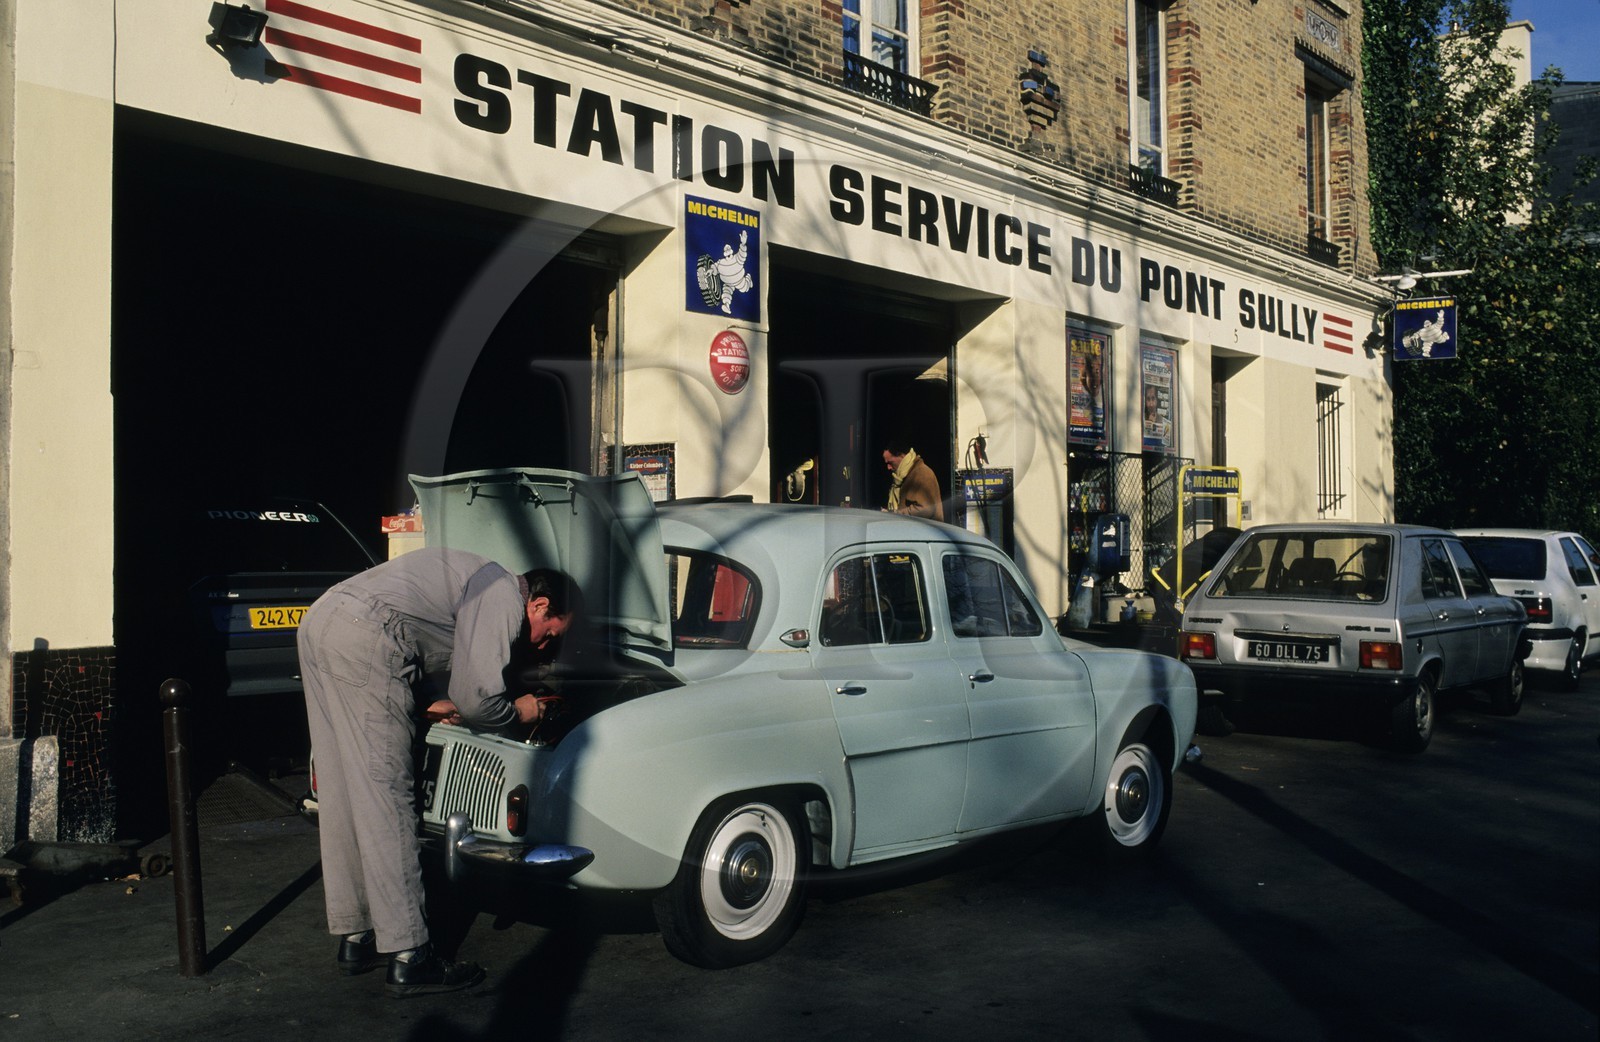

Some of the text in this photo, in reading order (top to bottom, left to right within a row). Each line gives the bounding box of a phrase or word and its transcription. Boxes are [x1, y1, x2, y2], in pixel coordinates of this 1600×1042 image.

[453, 53, 1318, 345] STATION SERVICE DU PONT SULLY
[688, 201, 758, 228] MICHELIN
[1396, 299, 1454, 310] MICHELIN
[1193, 476, 1238, 488] MICHELIN
[208, 510, 309, 522] PIONEER
[257, 609, 286, 626] 242
[1255, 643, 1321, 660] 60 DLL 75
